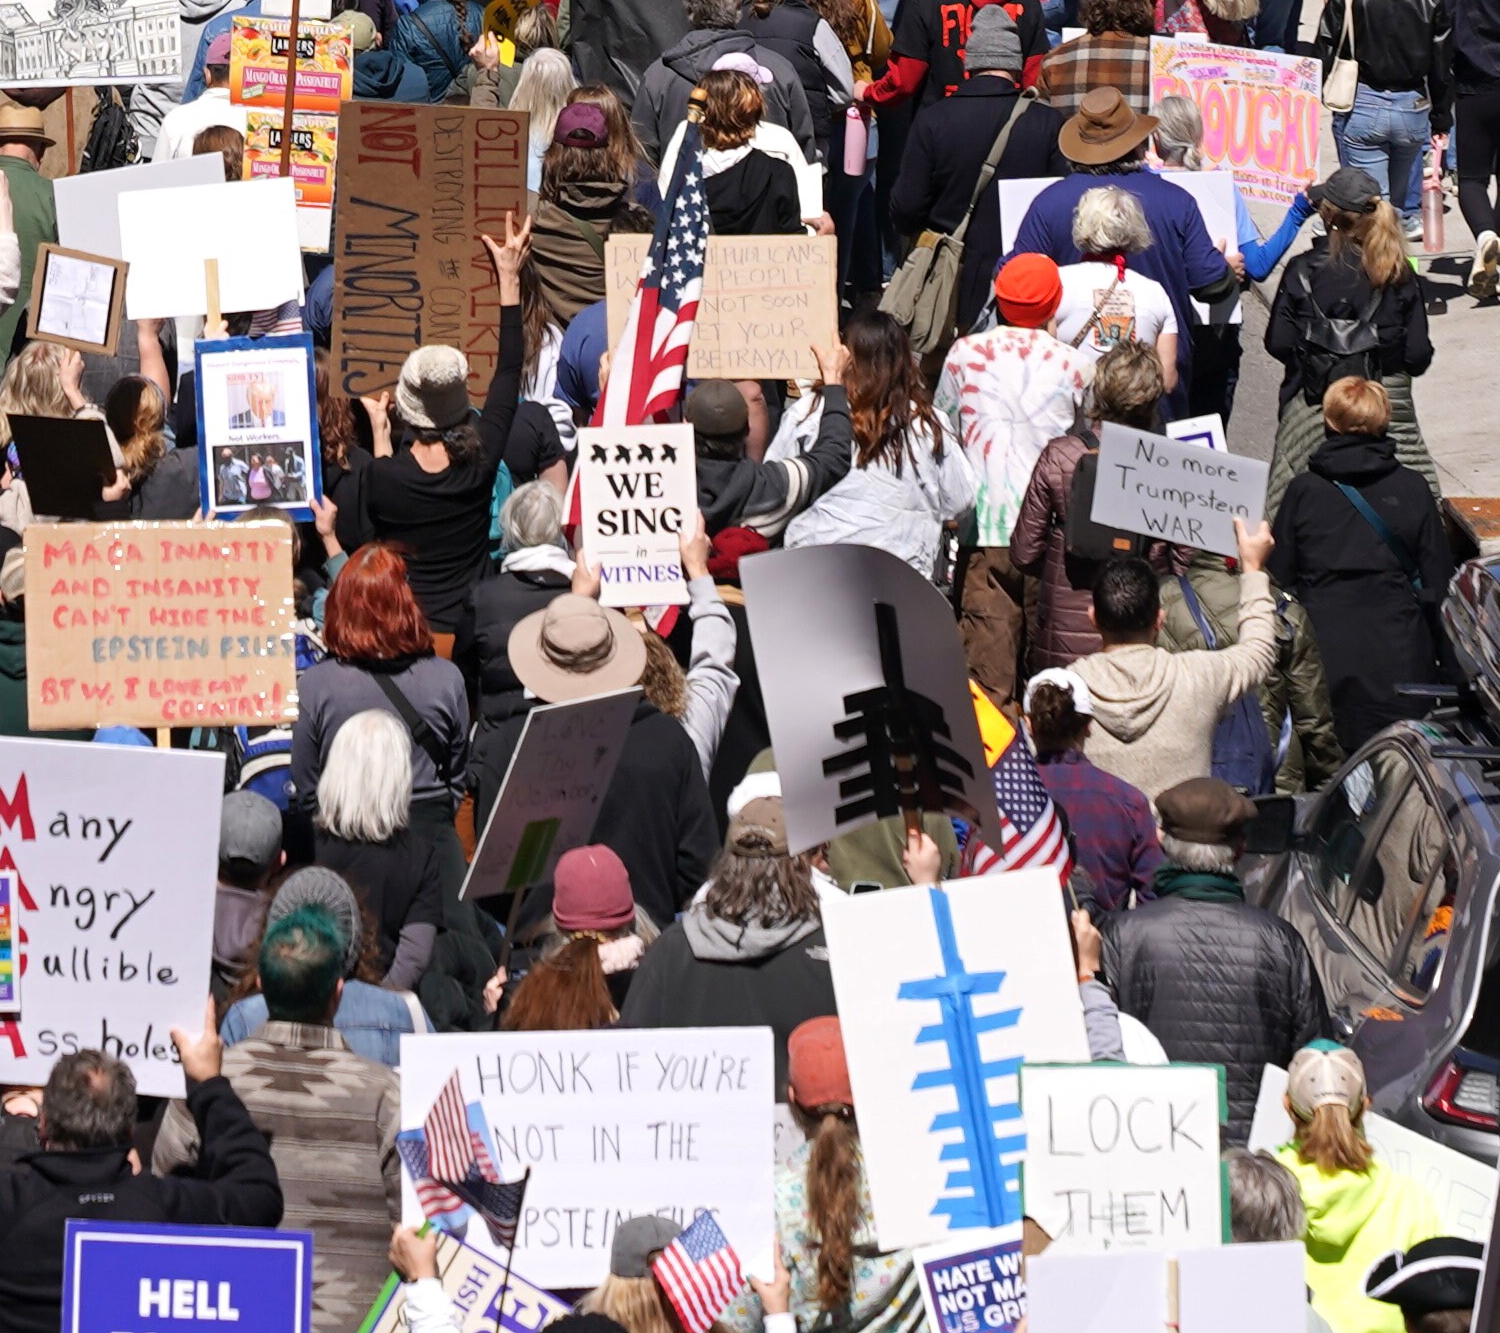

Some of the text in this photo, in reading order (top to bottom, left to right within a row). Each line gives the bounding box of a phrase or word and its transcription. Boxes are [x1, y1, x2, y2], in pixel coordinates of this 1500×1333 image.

[1134, 438, 1238, 483] No more
[605, 471, 665, 499] WE
[1115, 464, 1249, 521] Trumpstein
[597, 507, 683, 534] SING
[1142, 509, 1205, 544] WAR
[477, 1052, 751, 1096] HONK YOU'RE
[1047, 1095, 1205, 1157] LOCK
[1056, 1187, 1191, 1239] THEM
[139, 1277, 240, 1322] HELL
